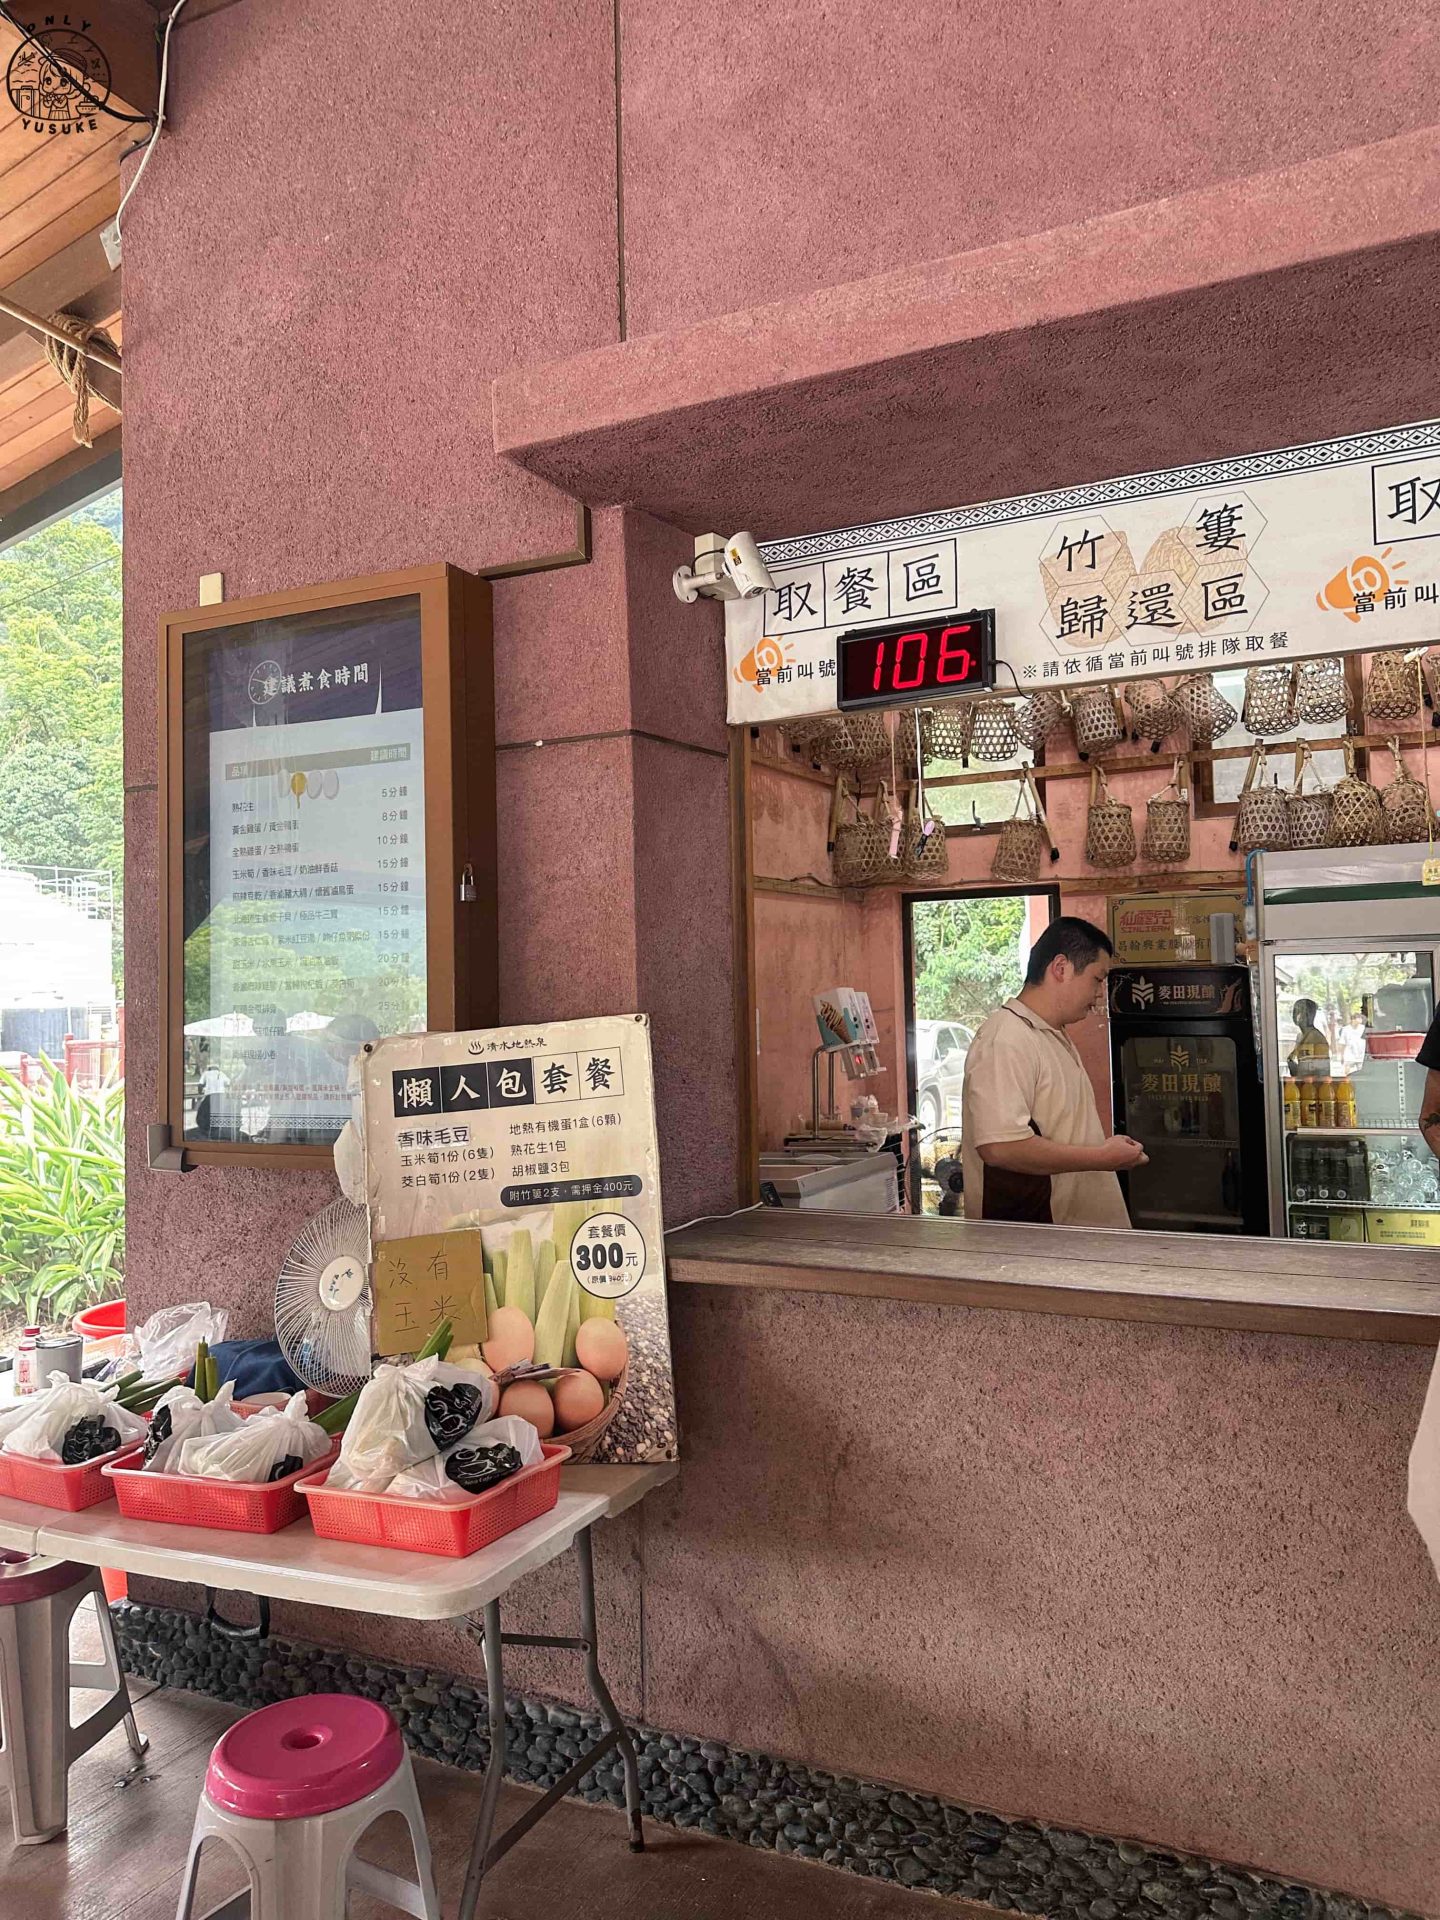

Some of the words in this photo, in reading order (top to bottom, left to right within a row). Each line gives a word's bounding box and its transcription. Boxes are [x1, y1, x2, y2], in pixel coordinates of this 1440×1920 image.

[771, 553, 944, 622] 取餐區
[1056, 573, 1249, 639] 歸還區
[755, 658, 836, 686] 當前叫號
[872, 625, 974, 691] 106
[263, 662, 369, 697] 建議煮食時間
[397, 1057, 616, 1109] 懶人包套餐
[398, 1126, 470, 1148] 香味毛豆
[510, 1140, 567, 1157] 熟花生1包
[512, 1161, 570, 1177] 胡椒鹽3包
[588, 1224, 626, 1239] 套餐價
[576, 1242, 639, 1271] 300元
[394, 1295, 462, 1333] 玉米
